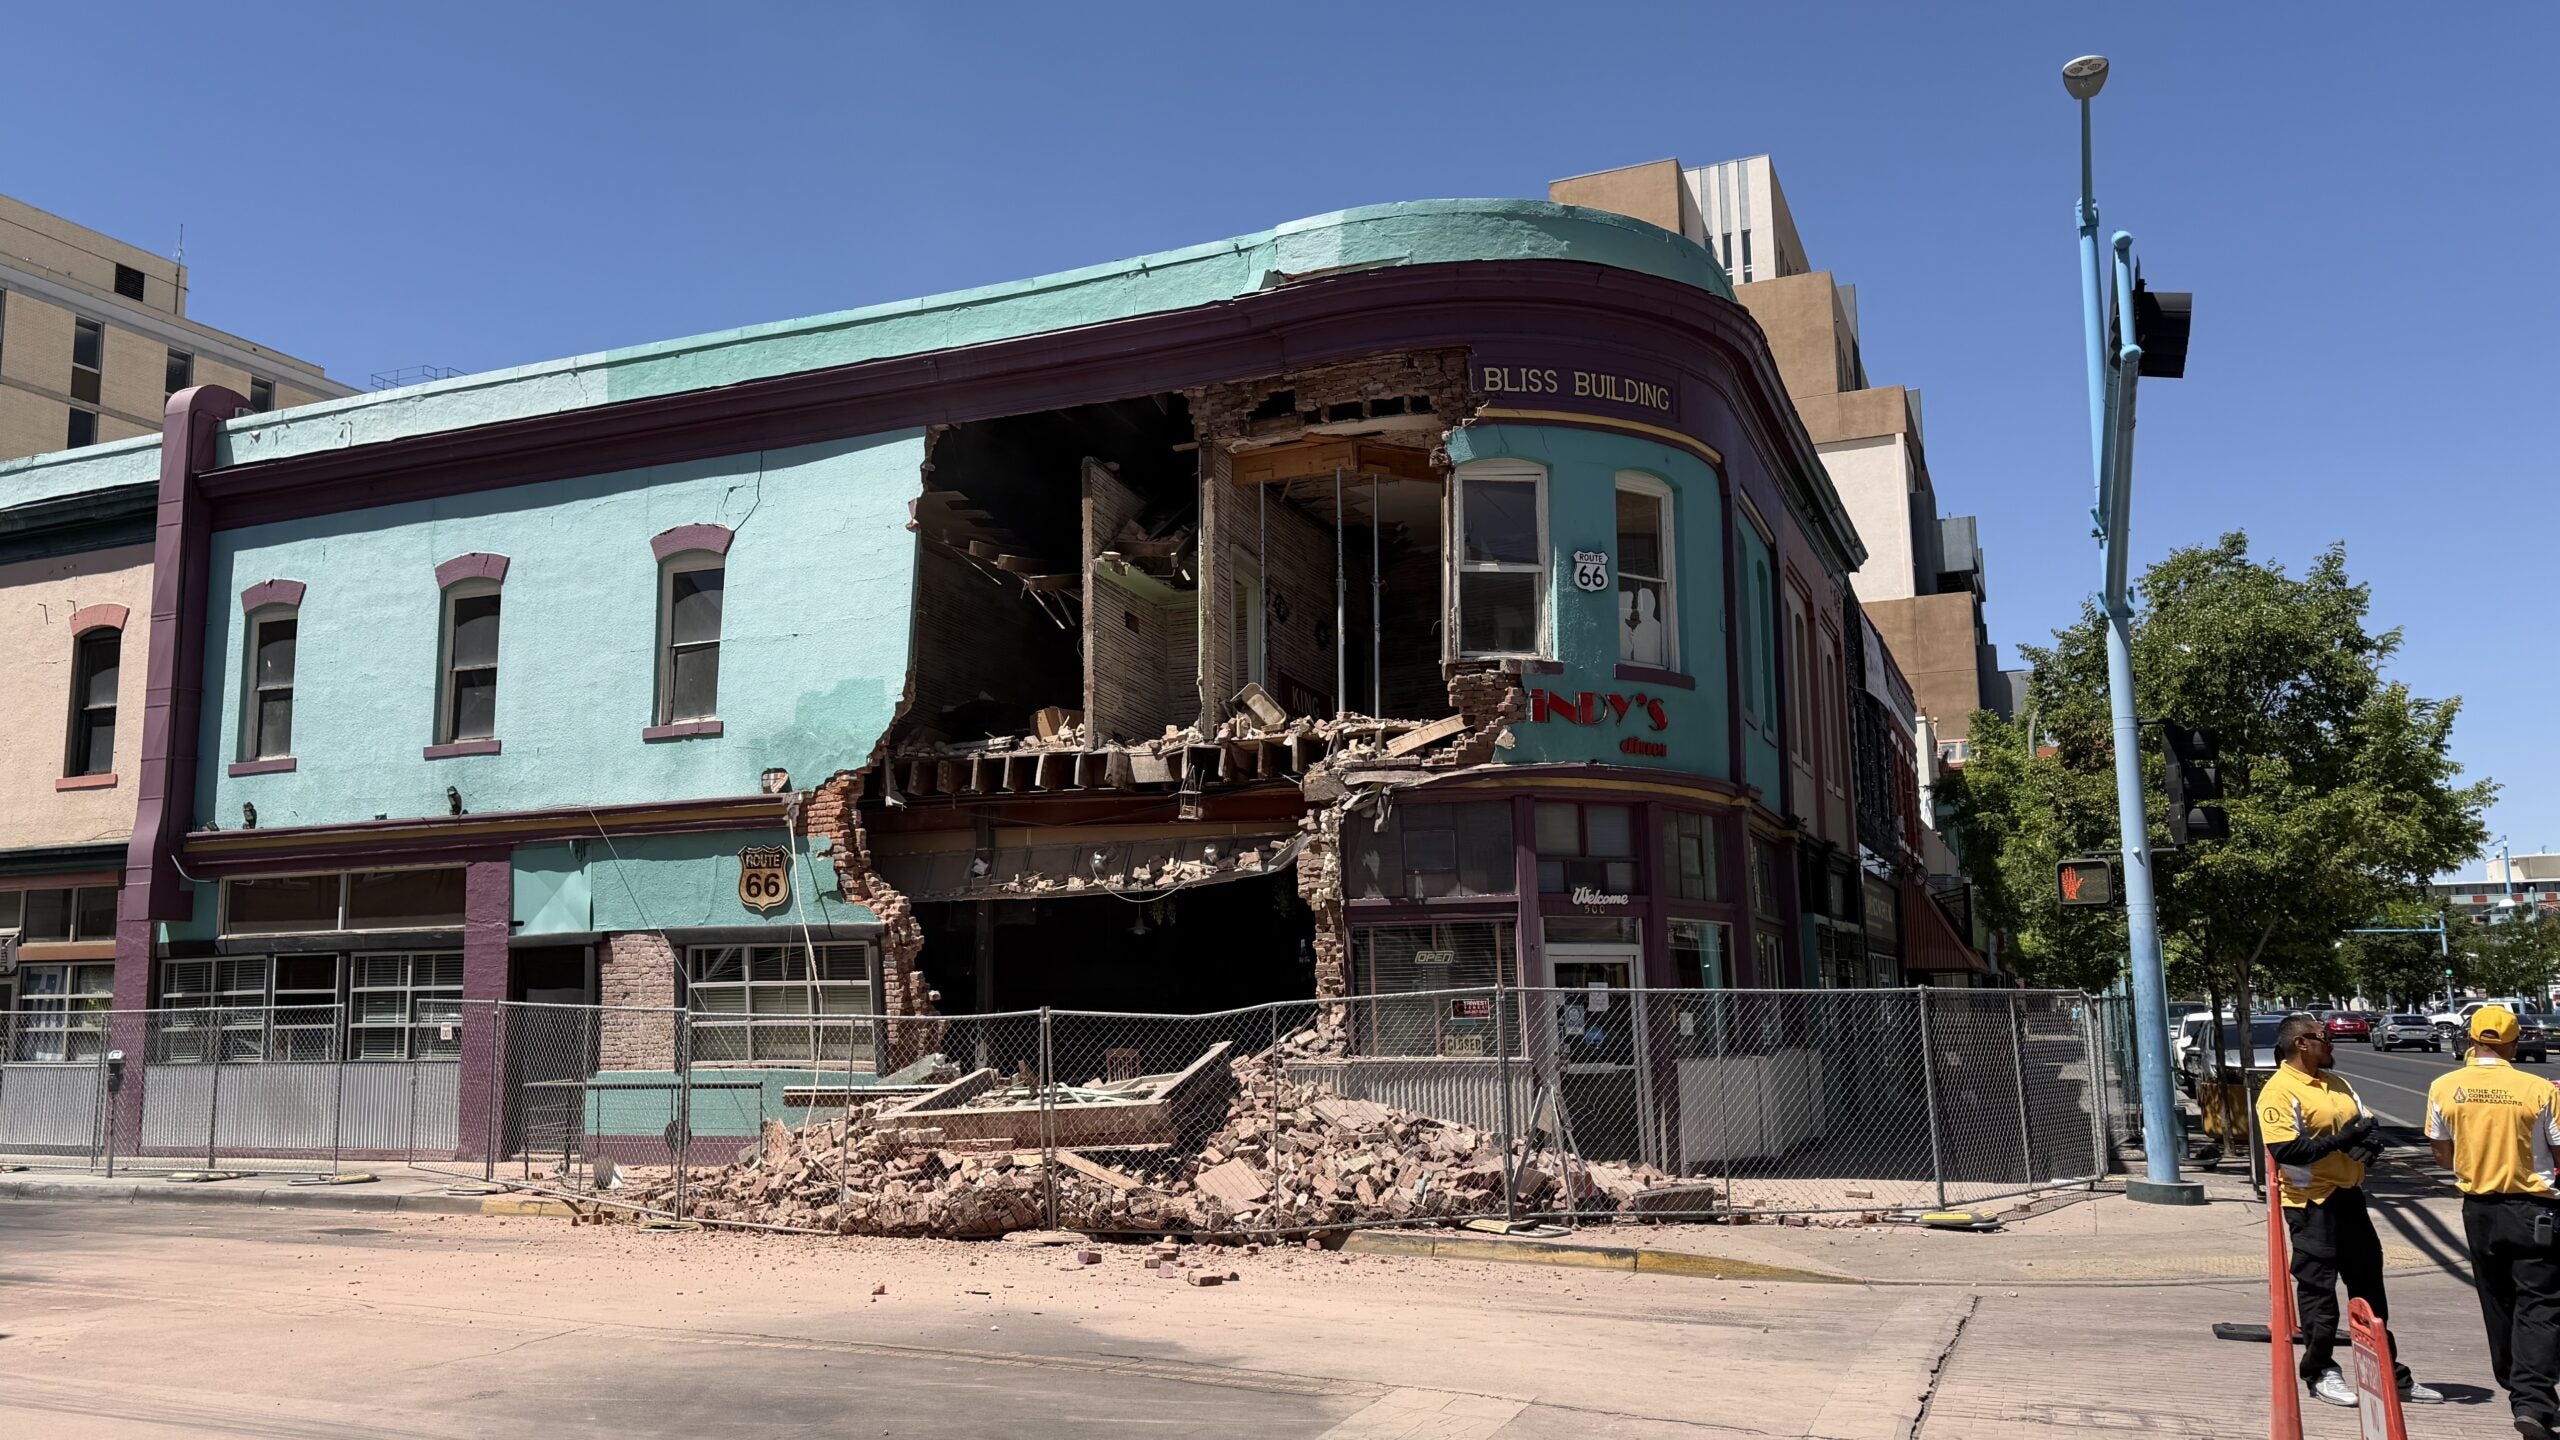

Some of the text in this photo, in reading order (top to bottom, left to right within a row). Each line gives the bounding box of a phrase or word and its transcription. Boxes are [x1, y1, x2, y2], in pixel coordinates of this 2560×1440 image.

[1483, 366, 1670, 411] BLISS BUILDING
[1579, 553, 1604, 563] ROUTE
[1578, 564, 1605, 588] 66
[745, 853, 781, 867] ROUTE
[745, 872, 780, 898] 66
[1572, 886, 1629, 905] Welcome
[1584, 904, 1606, 914] 500
[1418, 953, 1452, 962] OPEN
[1447, 1038, 1482, 1051] CLOSED
